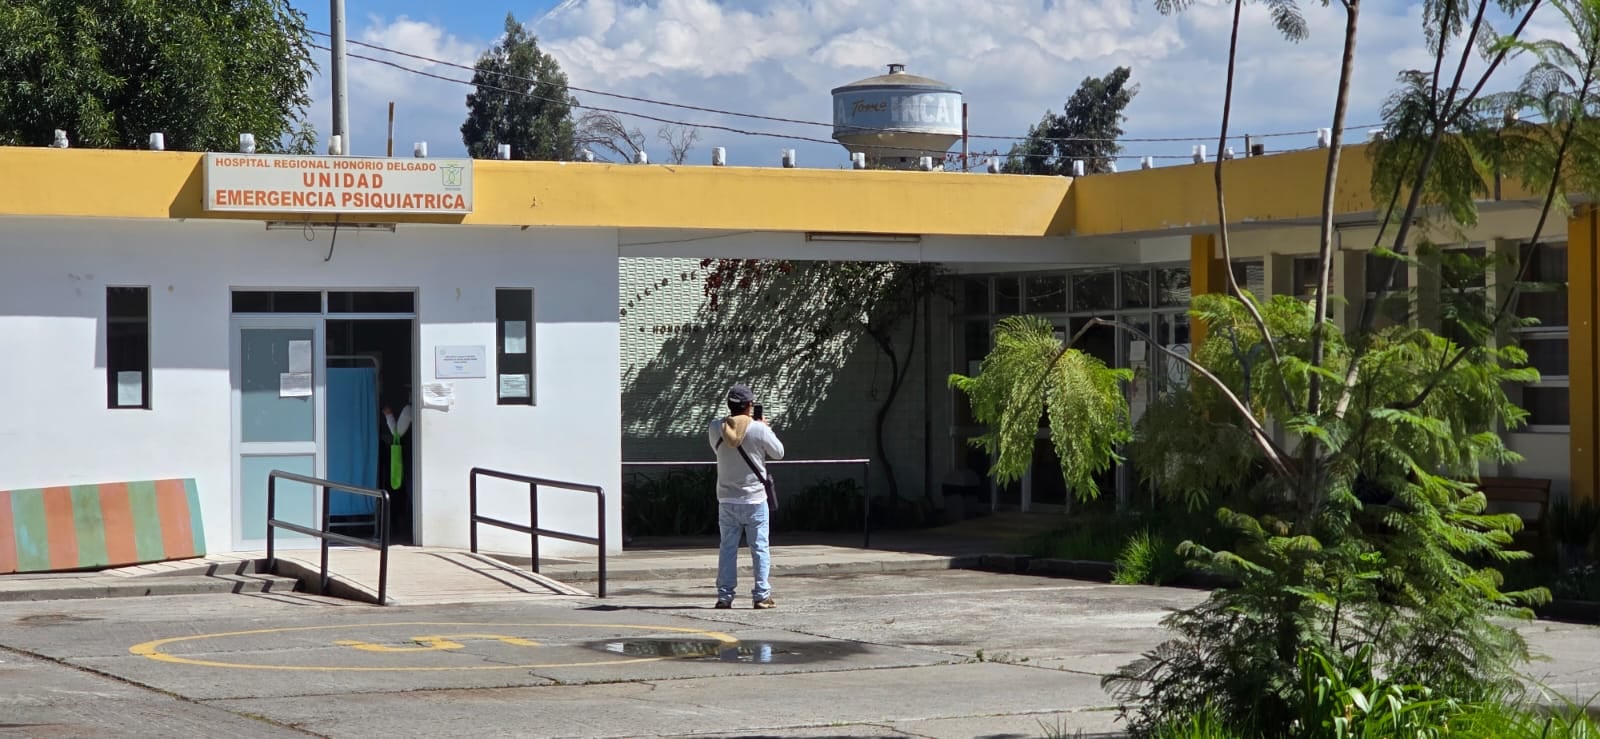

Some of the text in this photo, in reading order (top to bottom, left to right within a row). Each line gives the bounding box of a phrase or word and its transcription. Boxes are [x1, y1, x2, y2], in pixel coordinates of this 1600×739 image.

[891, 95, 950, 123] INCA
[215, 157, 437, 172] HOSPITAL REGIONAL HONORIO DELGADO
[303, 172, 384, 189] UNIDAD
[215, 189, 466, 209] EMERGENCIA PSIQUIATRICA
